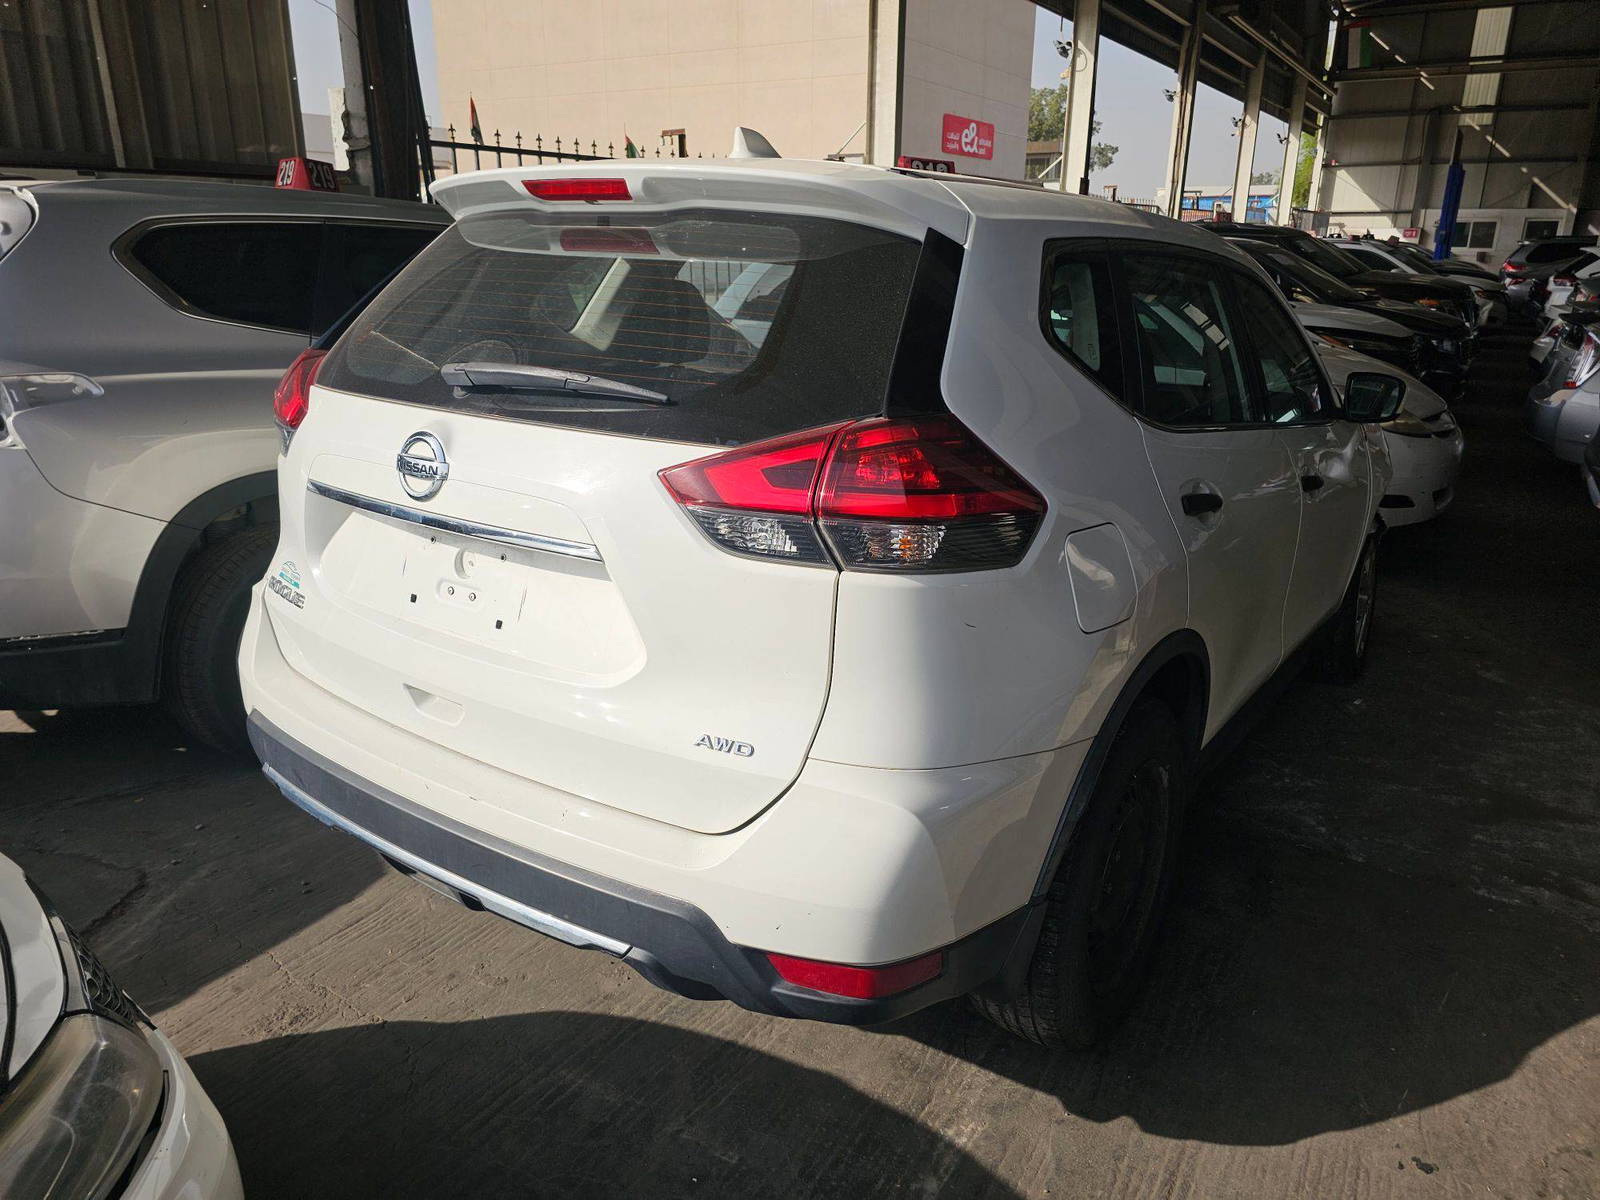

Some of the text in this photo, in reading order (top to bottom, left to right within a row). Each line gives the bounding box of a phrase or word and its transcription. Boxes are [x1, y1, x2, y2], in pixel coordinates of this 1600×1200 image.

[278, 160, 295, 186] 219
[309, 161, 335, 189] 219
[399, 457, 439, 476] NISSAN
[694, 733, 756, 758] AWD
